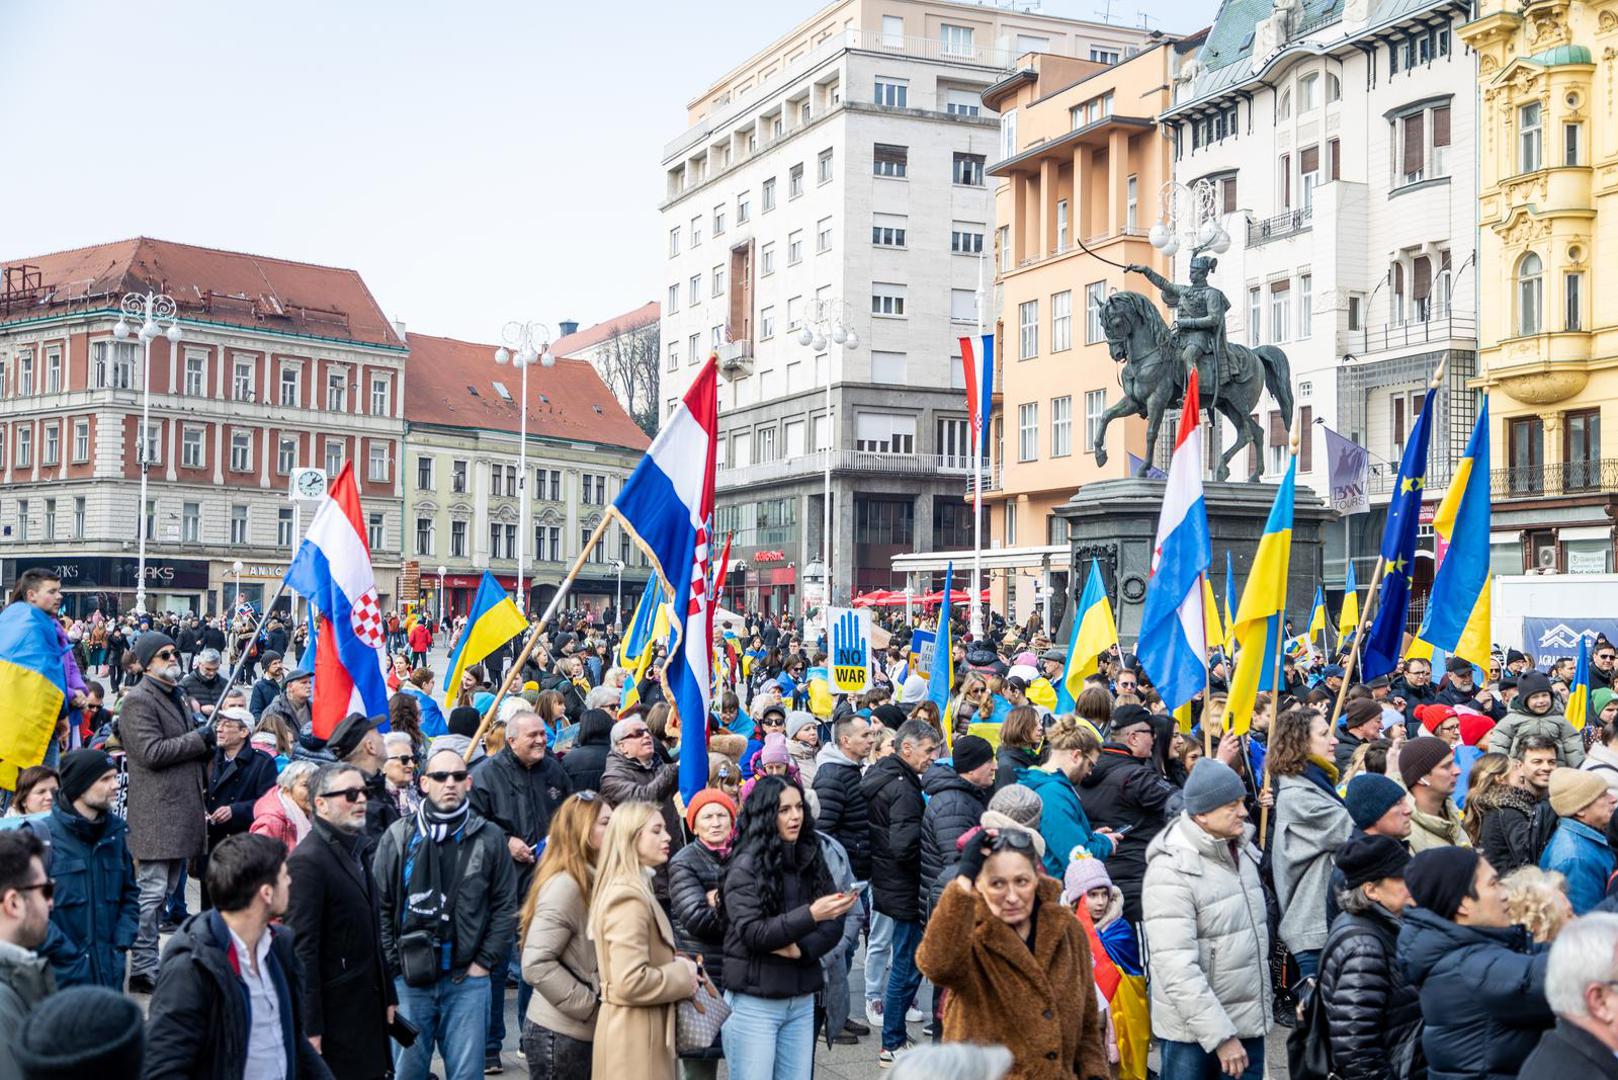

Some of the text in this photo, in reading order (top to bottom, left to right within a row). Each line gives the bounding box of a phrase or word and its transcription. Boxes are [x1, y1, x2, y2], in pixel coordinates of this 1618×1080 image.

[1334, 496, 1365, 509] TOURS
[839, 649, 862, 665] NO
[836, 668, 865, 683] WAR
